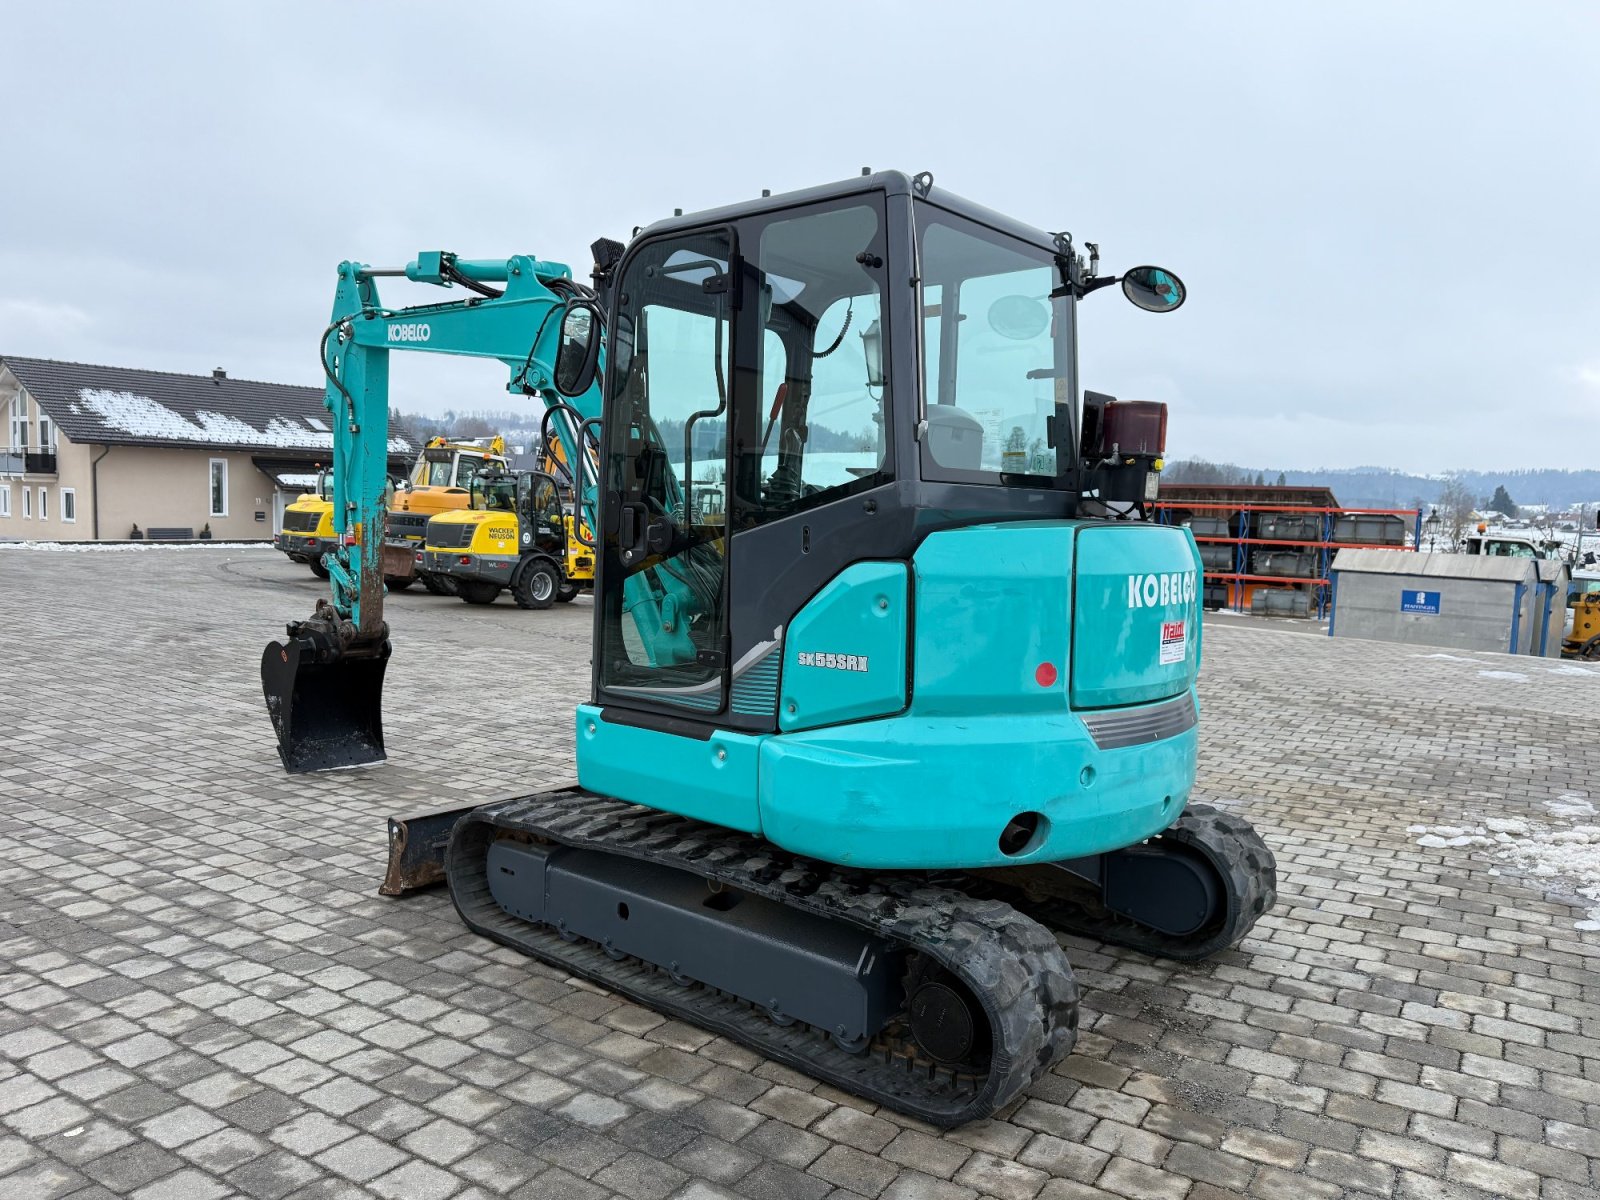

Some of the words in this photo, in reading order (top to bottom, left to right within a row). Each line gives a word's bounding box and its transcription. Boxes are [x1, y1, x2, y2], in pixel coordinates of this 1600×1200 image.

[387, 323, 431, 342] KOBELCO
[1128, 571, 1197, 609] KOBELCO
[798, 652, 869, 673] SK55SRX
